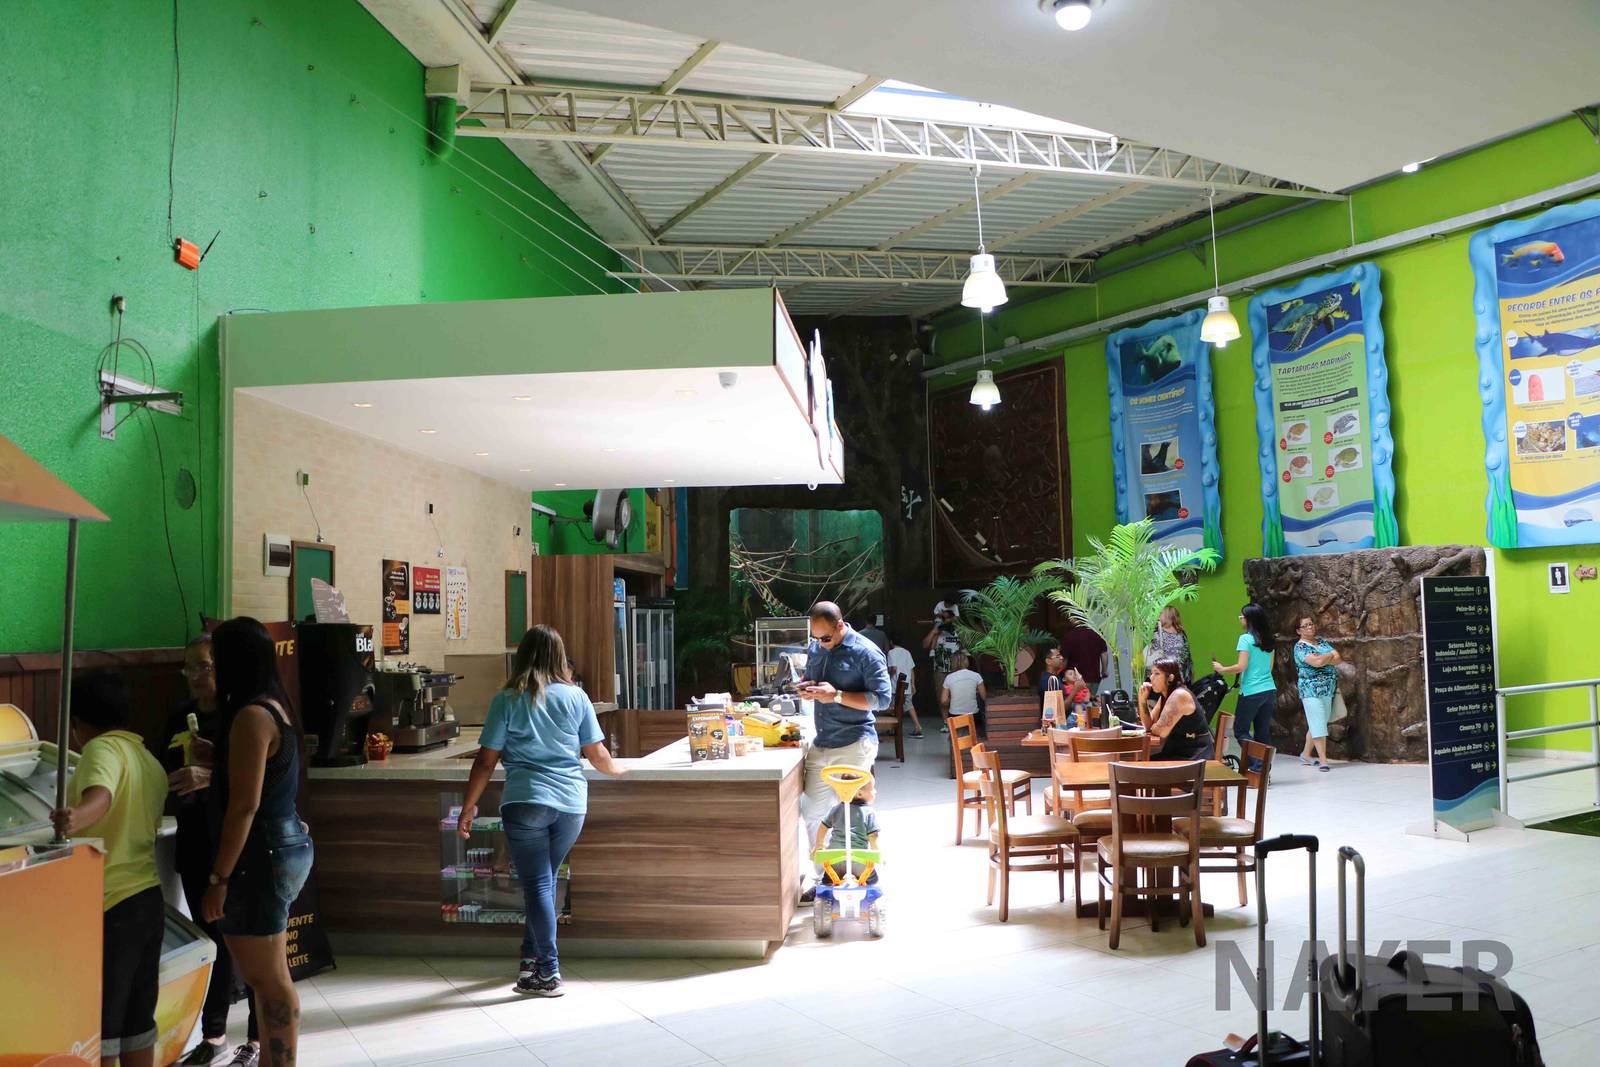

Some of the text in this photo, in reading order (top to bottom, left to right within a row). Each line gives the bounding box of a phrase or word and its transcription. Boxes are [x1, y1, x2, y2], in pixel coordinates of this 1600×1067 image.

[1507, 300, 1546, 312] RECORDE
[1549, 293, 1576, 306] ENTRE
[1579, 290, 1593, 299] OS
[1278, 361, 1319, 375] TARTARUGAS
[1581, 568, 1595, 576] WC
[288, 954, 309, 967] LEITE
